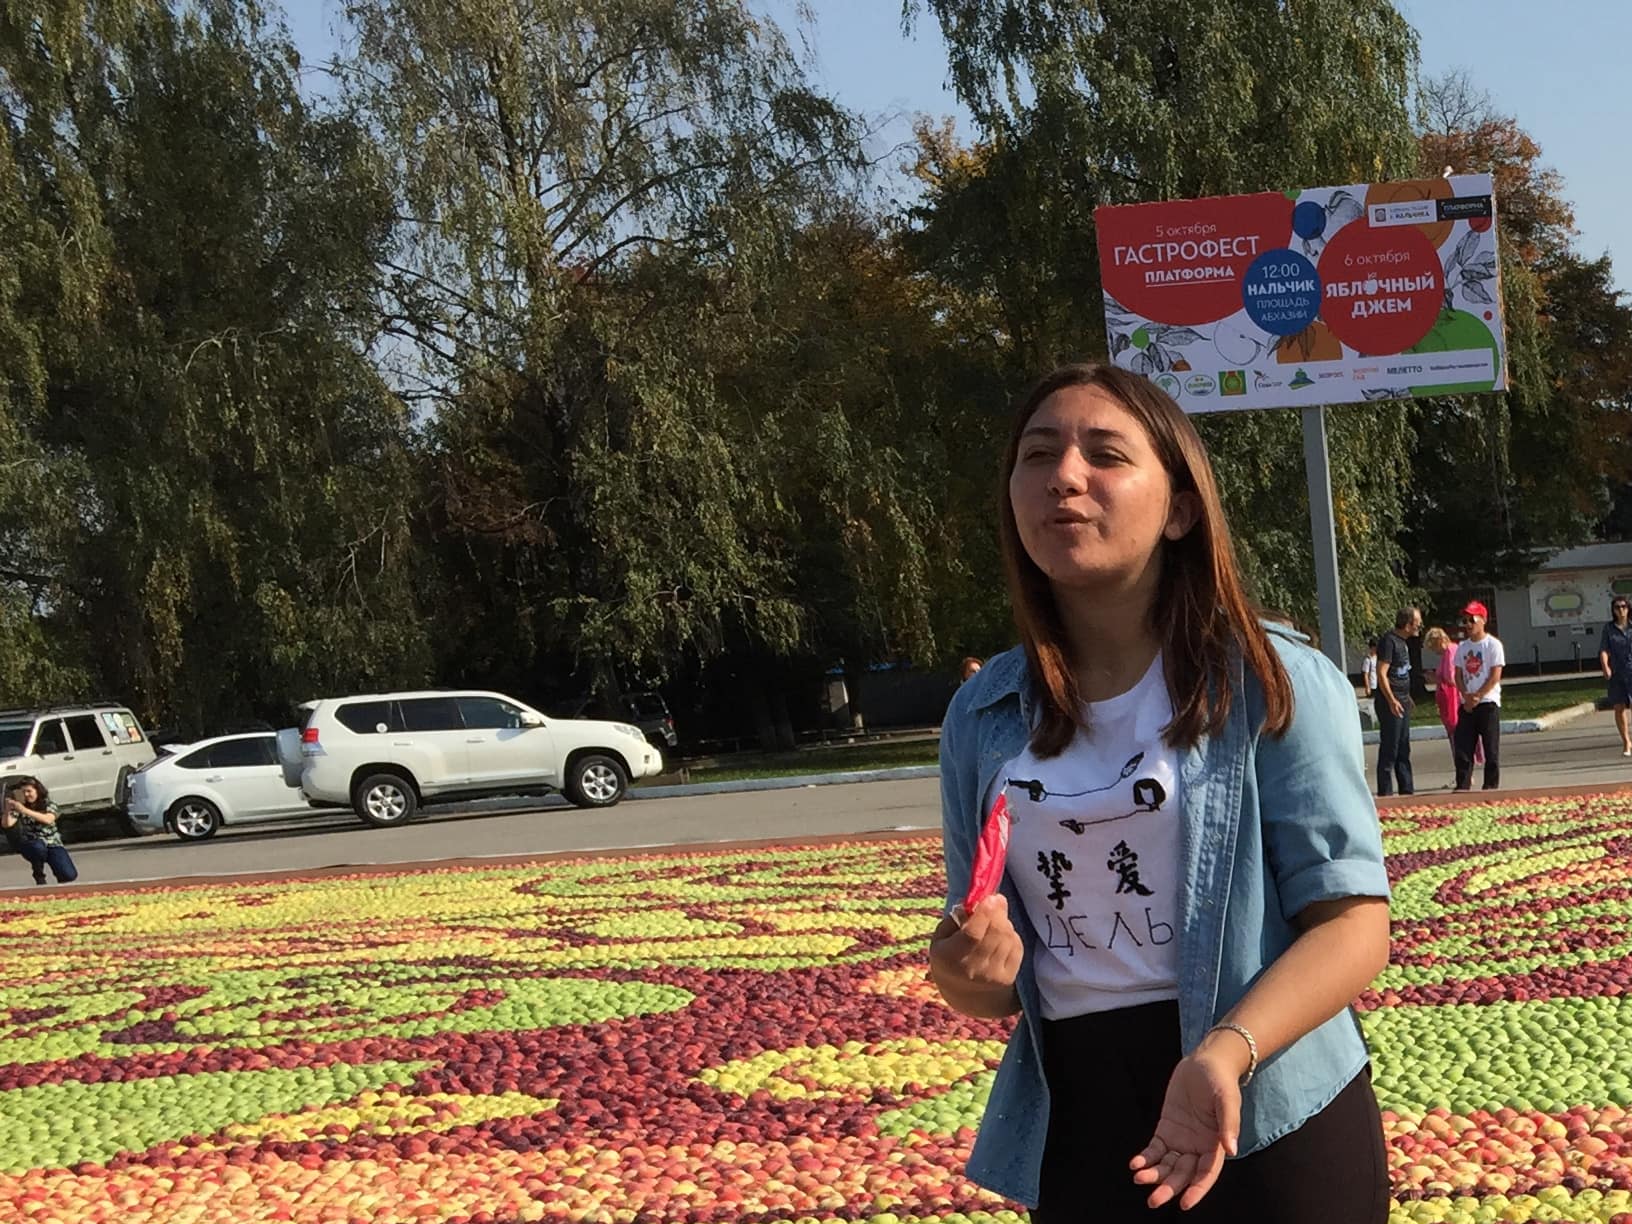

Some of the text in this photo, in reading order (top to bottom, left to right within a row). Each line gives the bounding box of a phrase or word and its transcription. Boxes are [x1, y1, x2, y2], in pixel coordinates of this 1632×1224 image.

[1155, 222, 1217, 238] 5 октября
[1114, 236, 1259, 265] ГАСТРОФЕСТ
[1344, 249, 1410, 266] 6 октября
[1145, 266, 1234, 283] ПЛАТФОРМА
[1262, 263, 1300, 279] 12:00
[1247, 280, 1315, 296] НАЛЬЧИК
[1256, 298, 1310, 310] ПЛОЩАДЬ
[1351, 297, 1412, 319] ДЖЕМ
[1261, 311, 1308, 321] АБХАЗИИ
[1045, 907, 1174, 956] ЦЕЛЬ
